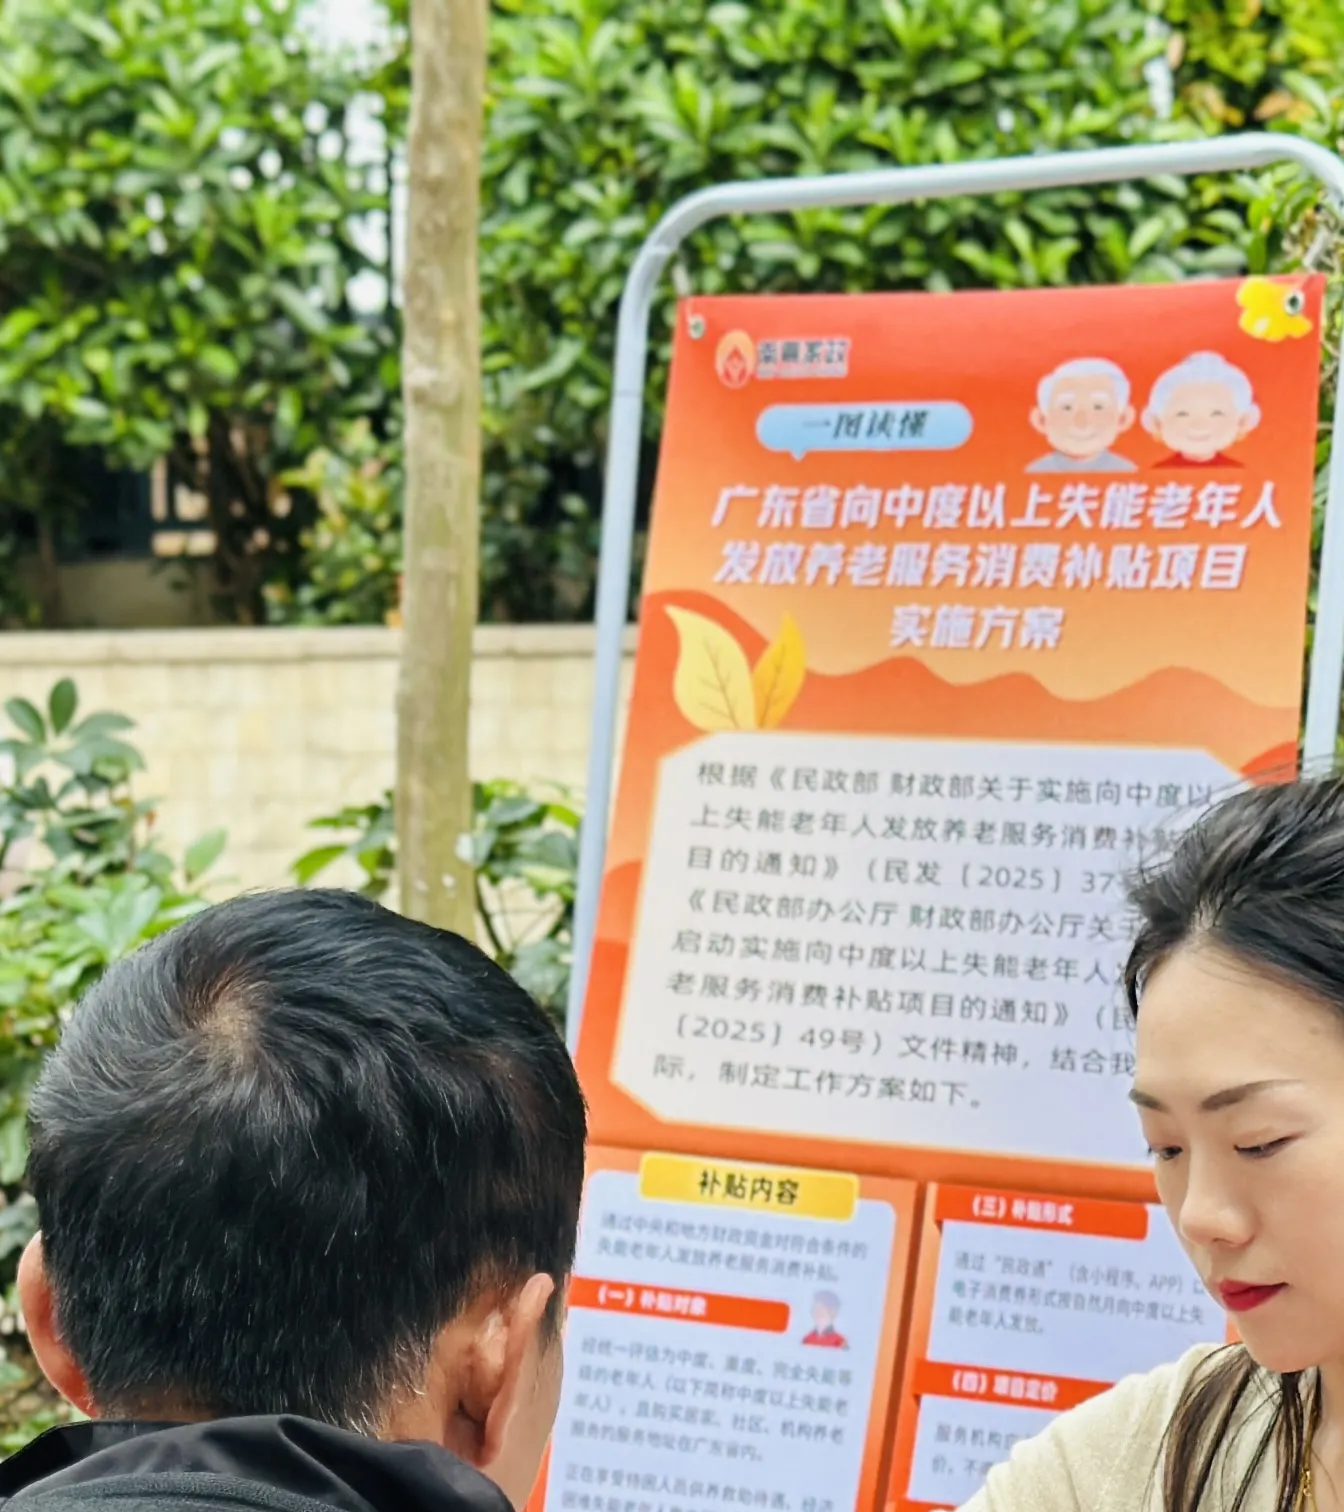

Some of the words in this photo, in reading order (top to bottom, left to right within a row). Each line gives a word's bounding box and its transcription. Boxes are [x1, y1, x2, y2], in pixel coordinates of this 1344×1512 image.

[803, 410, 930, 440] 一图读懂
[711, 481, 1284, 531] 广东省向中度以上失能老年人
[713, 542, 1248, 591] 发放养老服务消费补贴项目
[889, 604, 1065, 651] 实施方案
[697, 762, 879, 794] 根据《民政部
[890, 769, 1212, 808] 财政部关于实施向中度以
[689, 887, 898, 927] 《民政部办公厅
[910, 905, 1143, 941] 财政部办公厅关于
[654, 1054, 982, 1110] 际，制定工作方案如下。
[698, 1170, 800, 1205] 补贴内容
[598, 1237, 840, 1282] 失能老年人发放养老服务消费补贴。
[600, 1213, 868, 1260] 通过中央和地方财政资金对符合条件的
